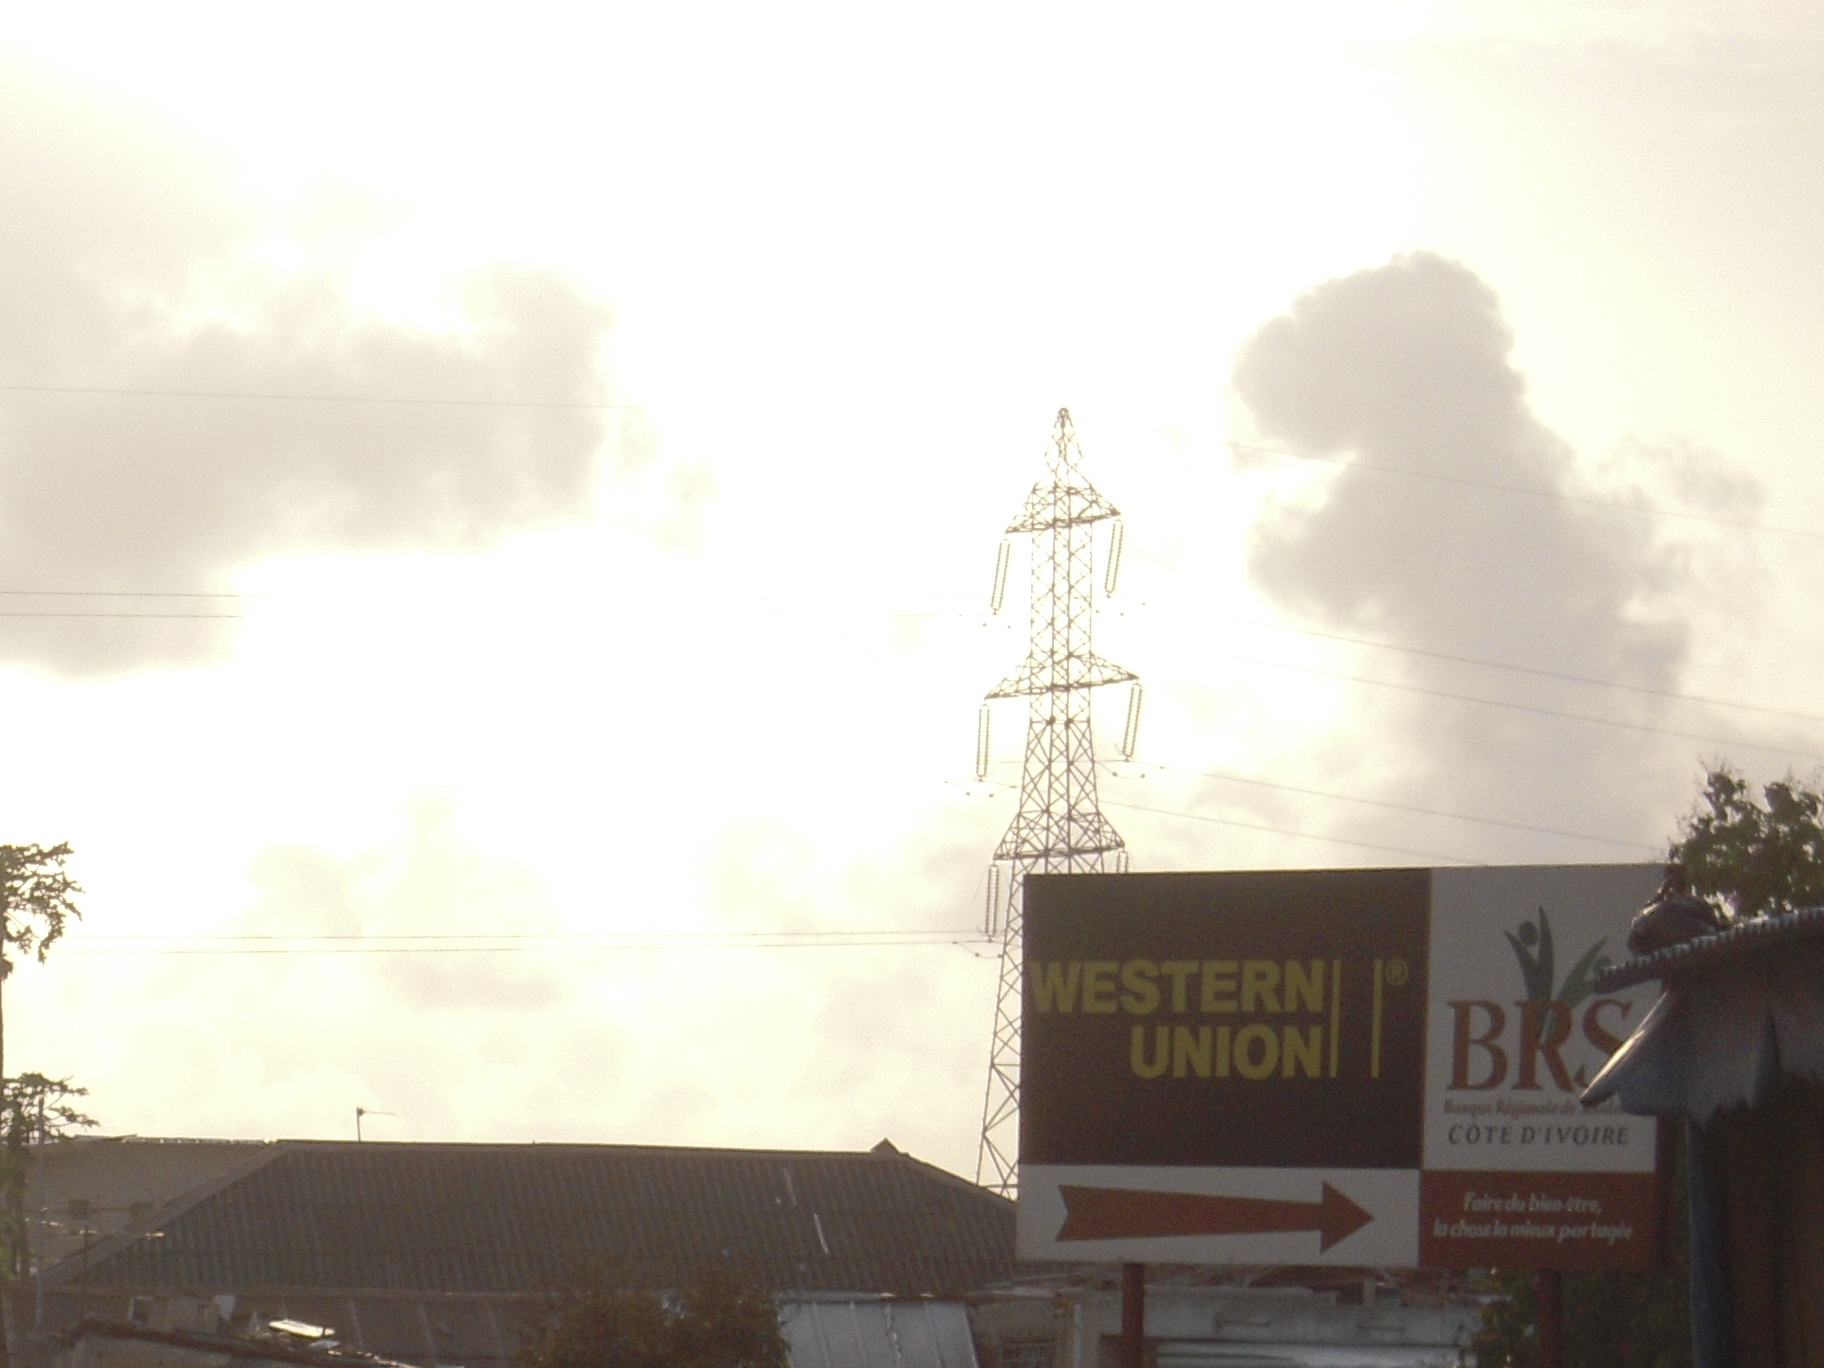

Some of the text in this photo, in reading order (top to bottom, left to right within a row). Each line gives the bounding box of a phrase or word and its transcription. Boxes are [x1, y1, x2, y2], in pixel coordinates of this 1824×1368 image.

[1029, 959, 1325, 1015] WESTERN
[1129, 1023, 1323, 1080] UNION
[1446, 998, 1633, 1093] BRS
